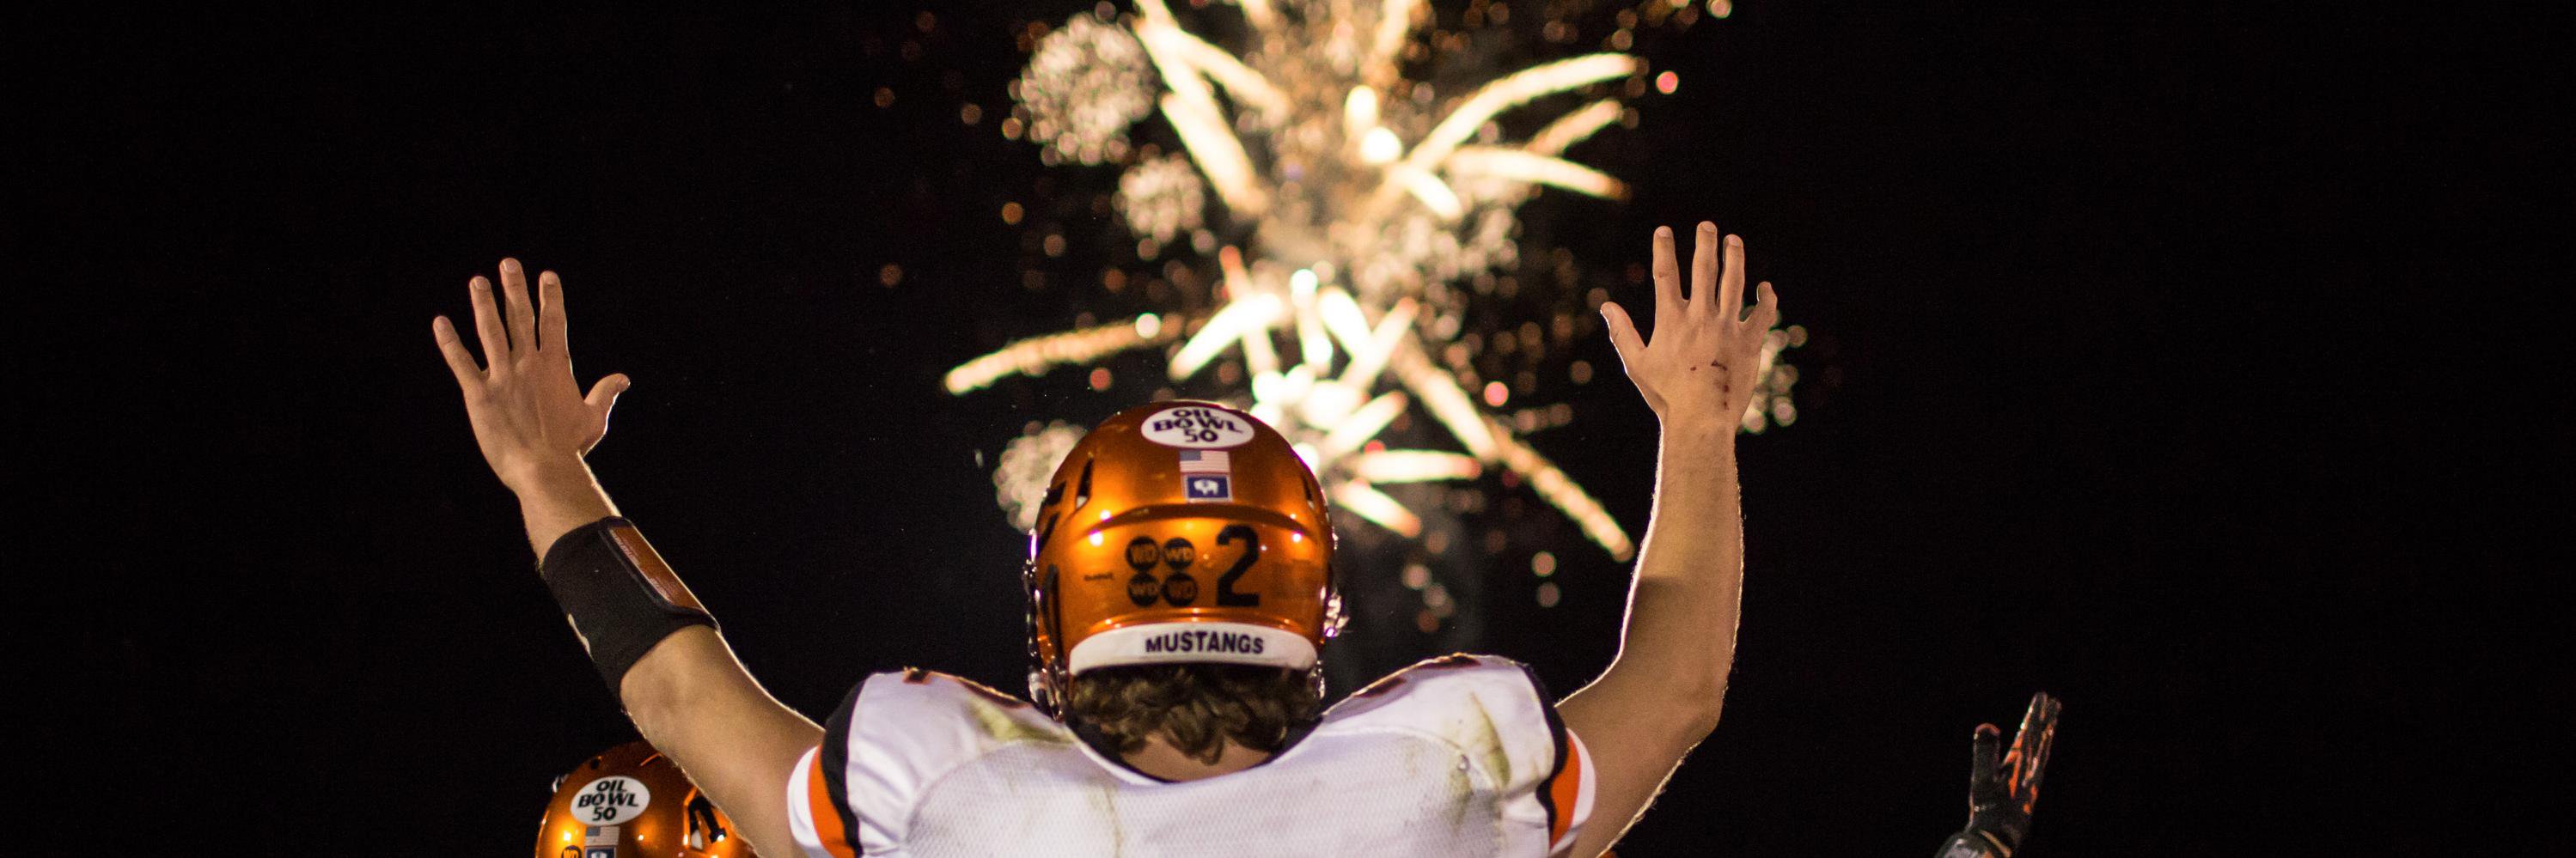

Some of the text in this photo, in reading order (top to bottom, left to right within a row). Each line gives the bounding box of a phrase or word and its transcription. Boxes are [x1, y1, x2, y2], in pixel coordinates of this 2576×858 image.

[1172, 409, 1220, 420] OIL
[1153, 417, 1243, 434] BOWL
[1183, 429, 1218, 442] 50
[1217, 525, 1259, 605] 2
[1146, 632, 1264, 654] MUSTANGS
[596, 780, 626, 791] OIL
[578, 793, 638, 807] BOWL
[593, 807, 616, 820] 50
